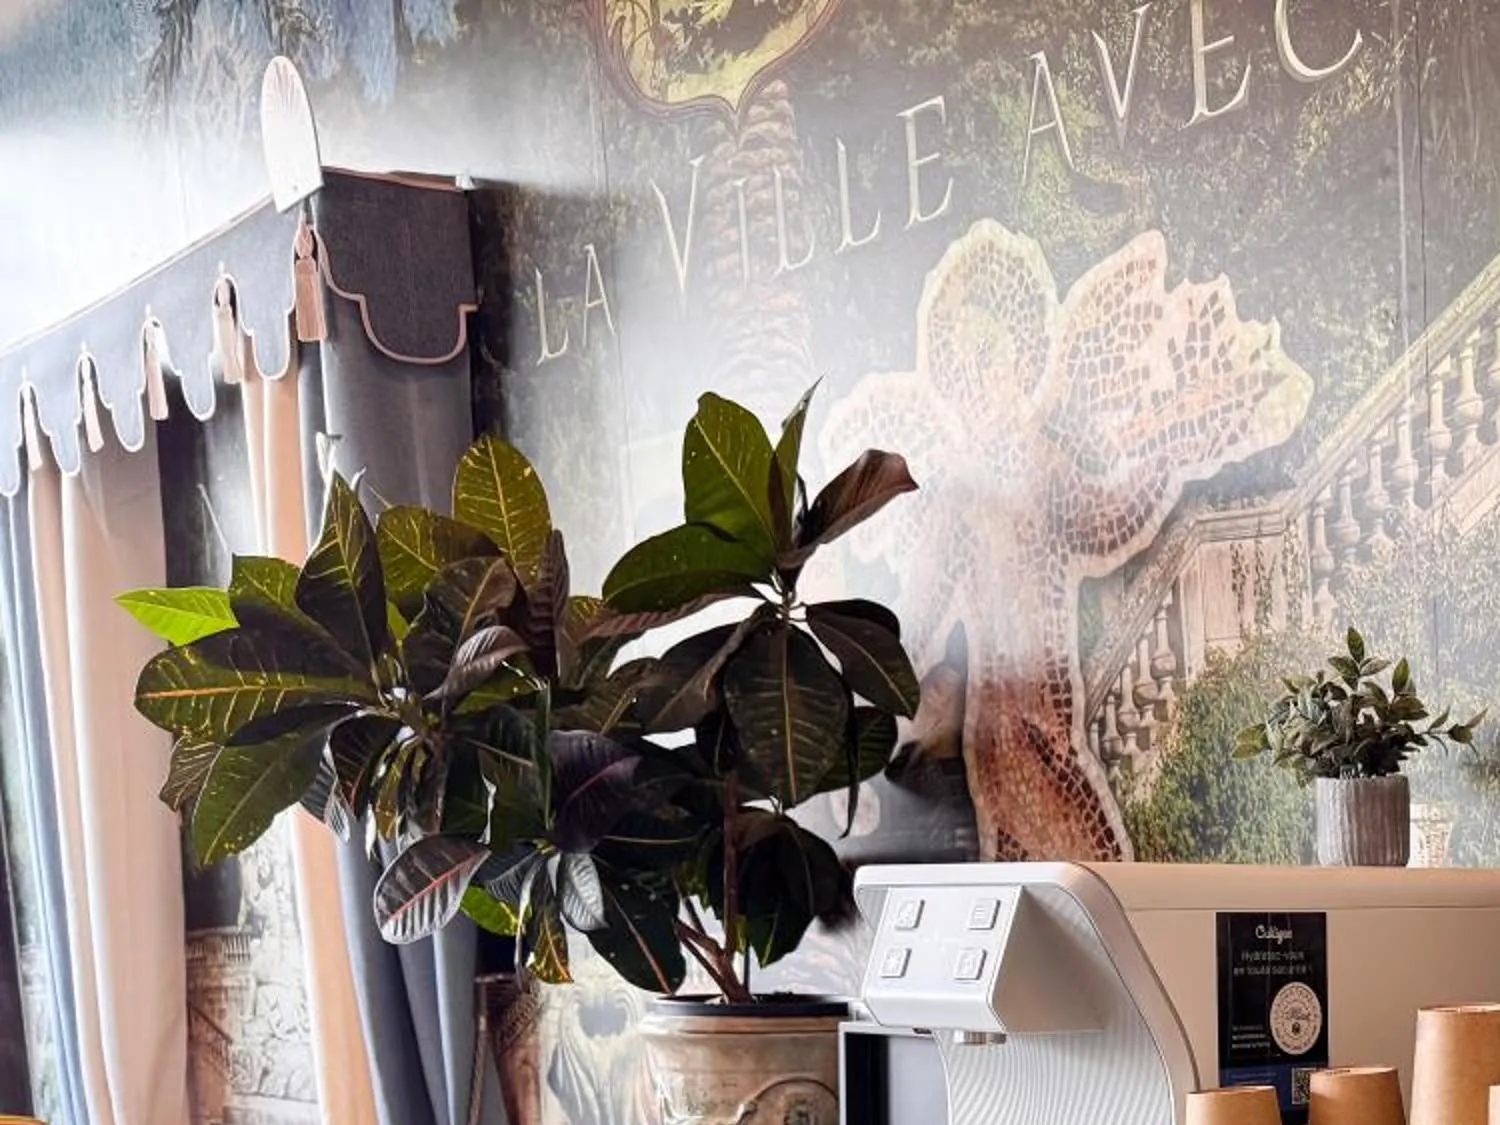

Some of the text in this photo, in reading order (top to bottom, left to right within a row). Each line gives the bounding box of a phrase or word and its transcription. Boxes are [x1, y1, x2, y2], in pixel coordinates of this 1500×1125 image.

[535, 0, 1363, 368] LA VILLE AVEC
